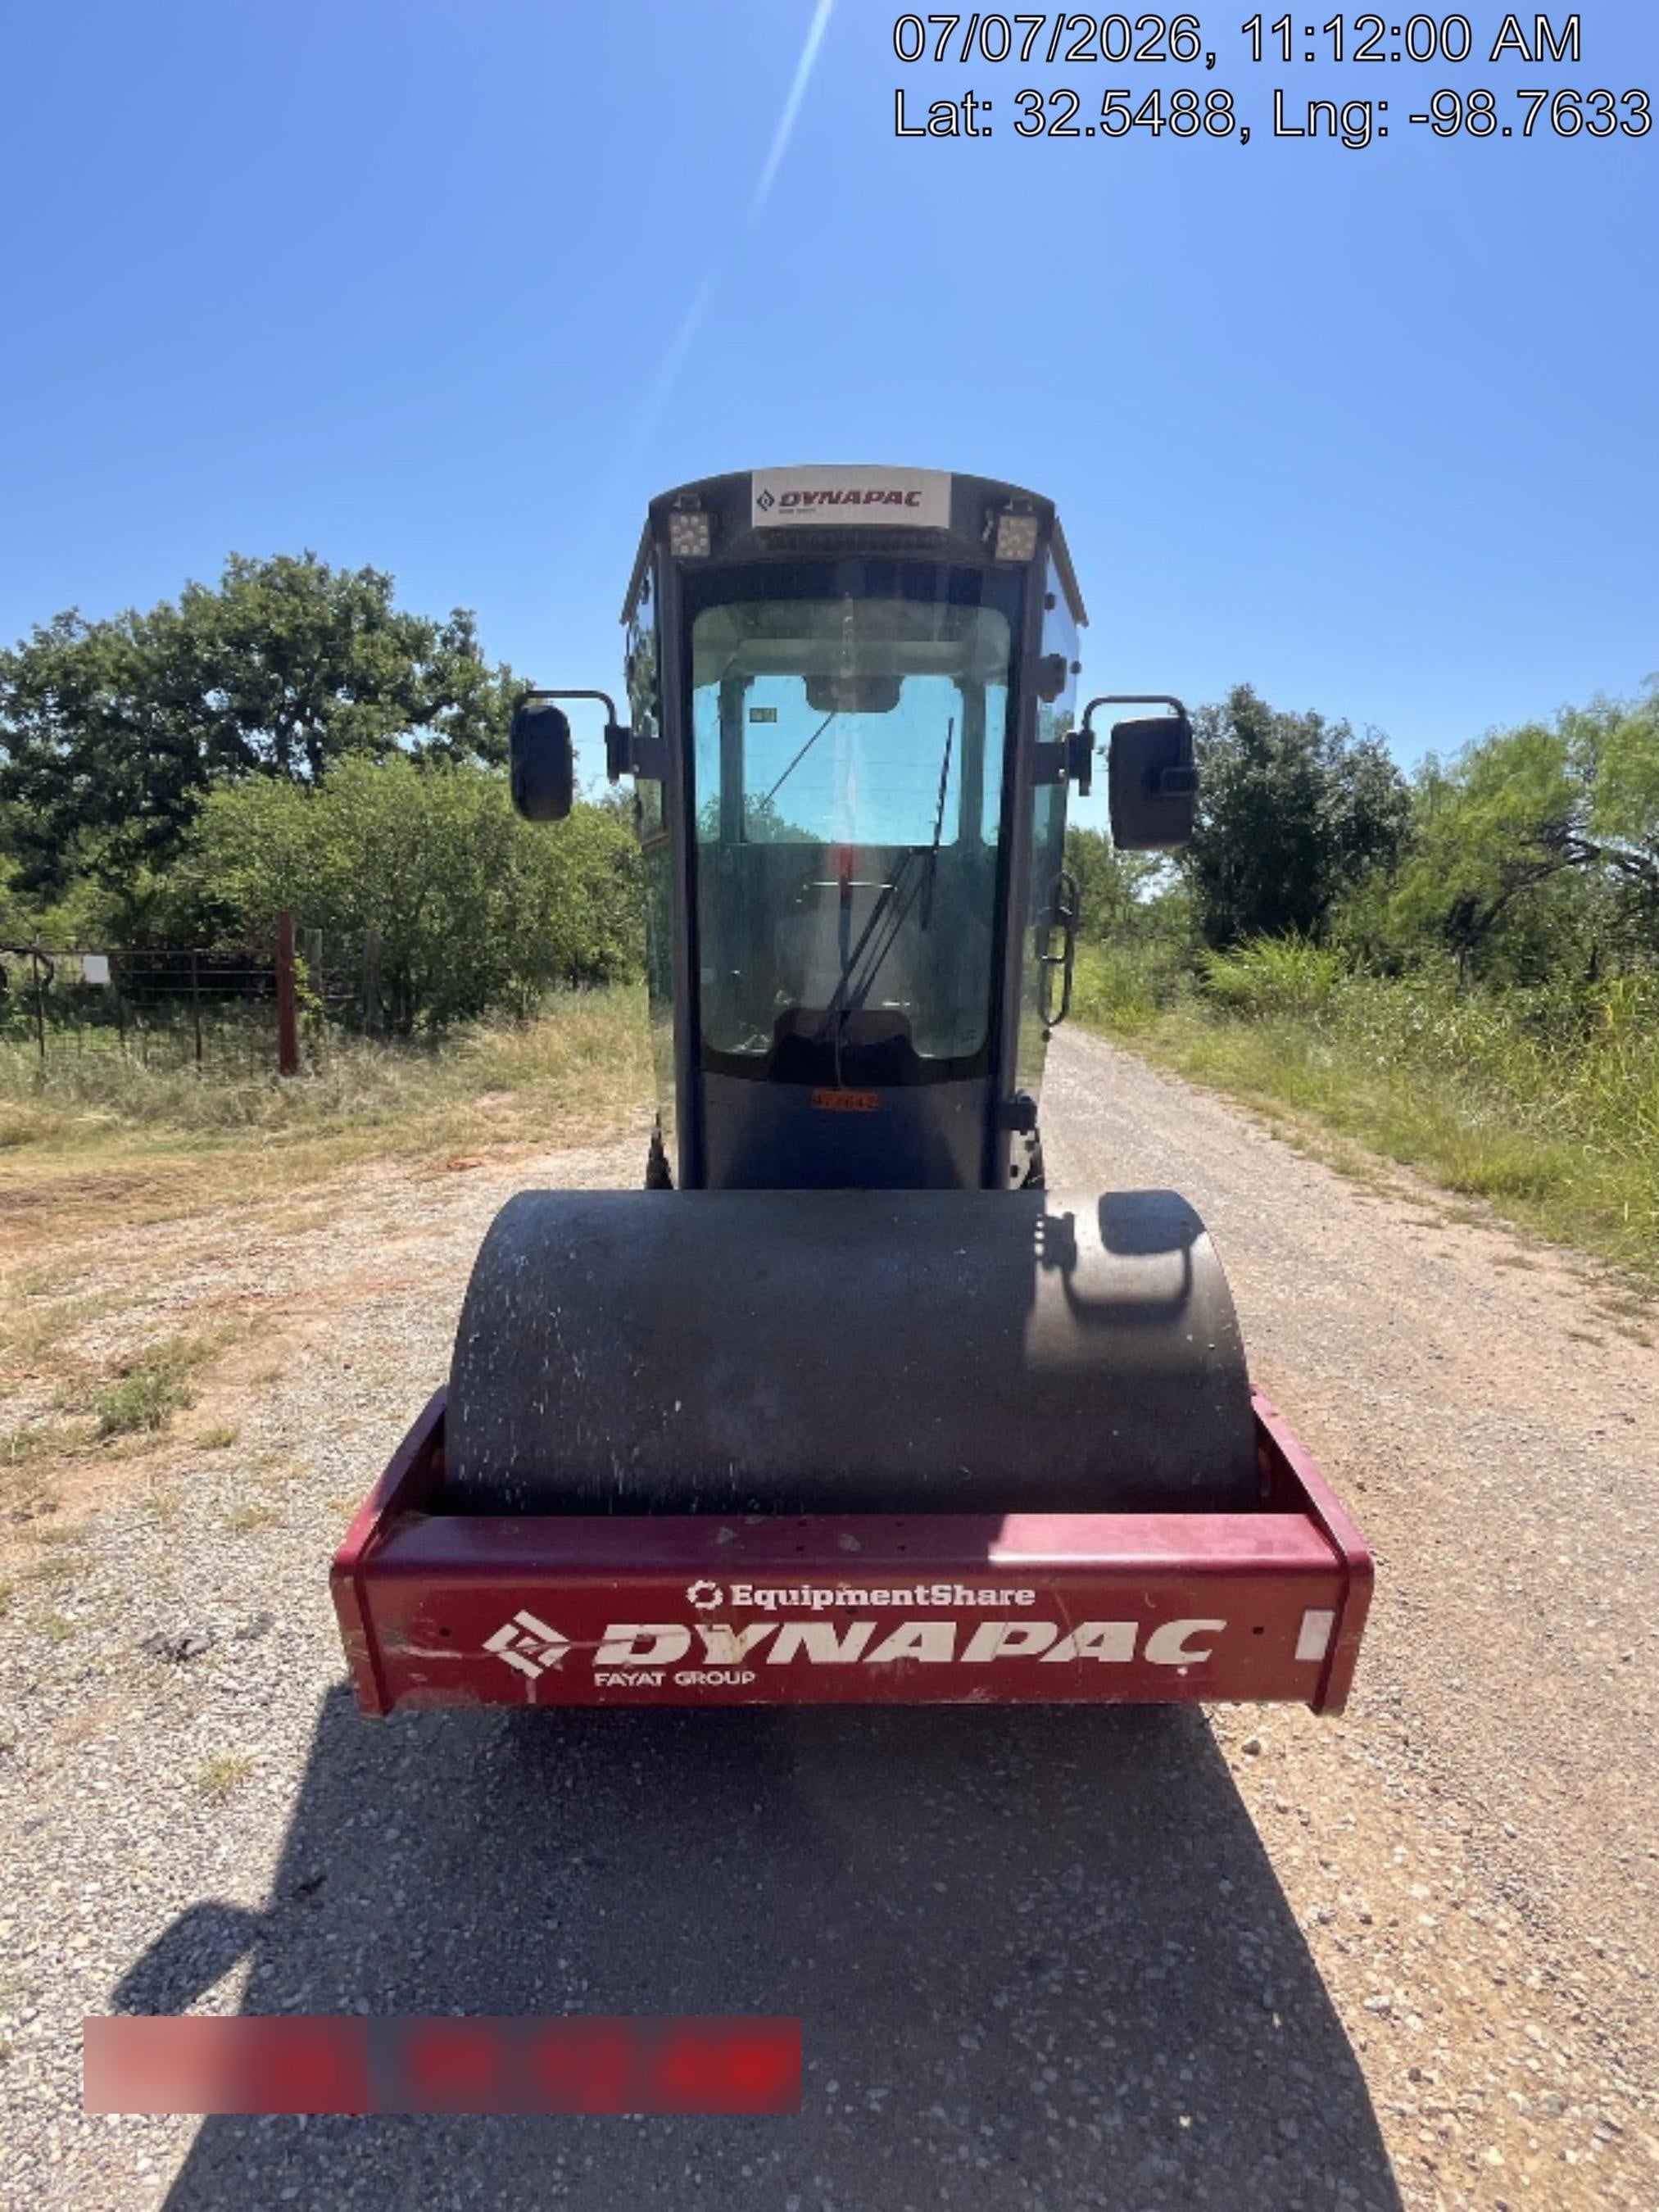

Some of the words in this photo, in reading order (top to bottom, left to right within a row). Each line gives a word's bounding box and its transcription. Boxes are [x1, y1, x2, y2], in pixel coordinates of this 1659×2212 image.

[778, 490, 922, 507] DYNAPAC
[730, 1583, 1036, 1611] EquipmentShare
[593, 1619, 1227, 1665] DYNAPAC
[593, 1671, 666, 1686] FAYAT
[674, 1670, 756, 1686] GROUP
